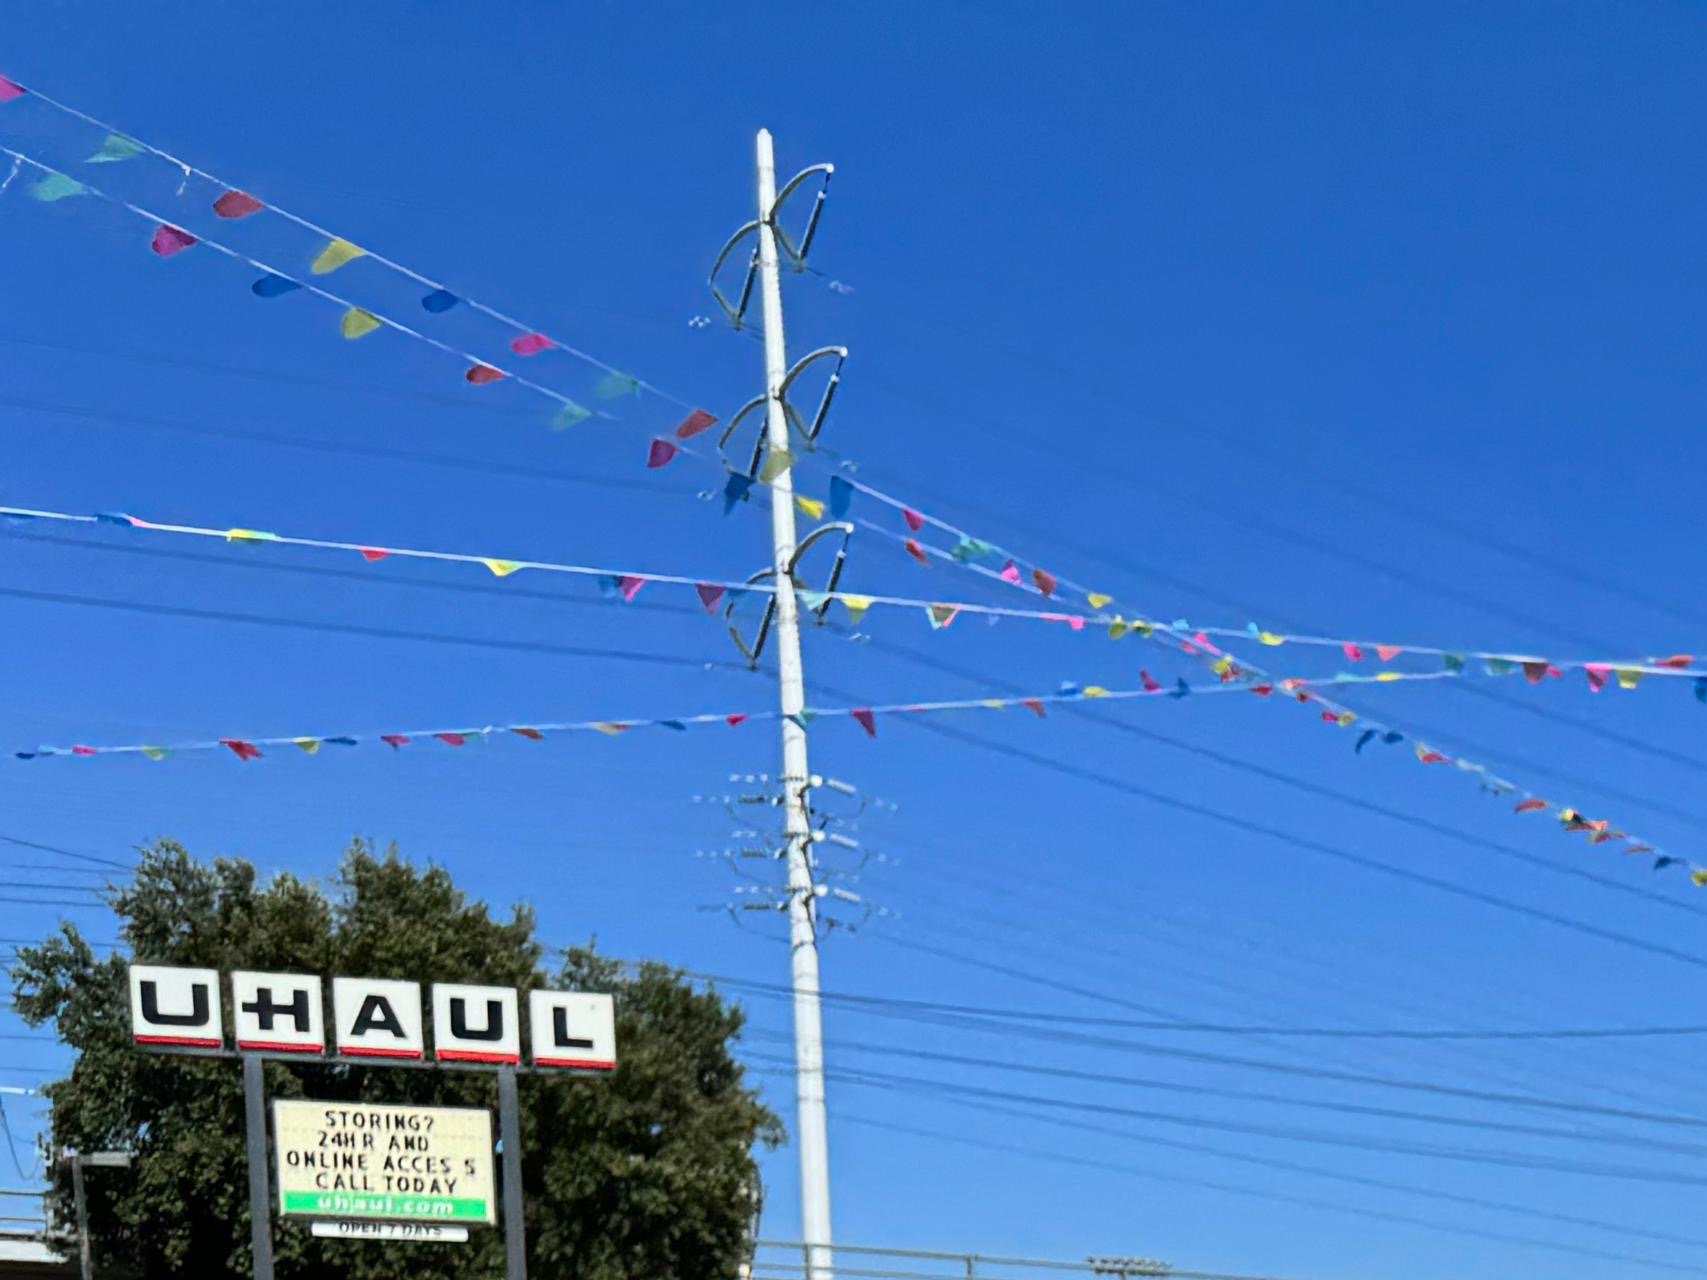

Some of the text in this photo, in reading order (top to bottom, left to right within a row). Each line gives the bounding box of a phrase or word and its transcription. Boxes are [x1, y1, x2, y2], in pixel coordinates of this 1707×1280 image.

[325, 1110, 434, 1131] STORING?
[389, 1134, 429, 1152] AND
[287, 1151, 368, 1169] ONLINE
[316, 1173, 457, 1194] CALL TODAY
[318, 1195, 454, 1216] uhaul.com
[339, 1221, 382, 1234] OPEN
